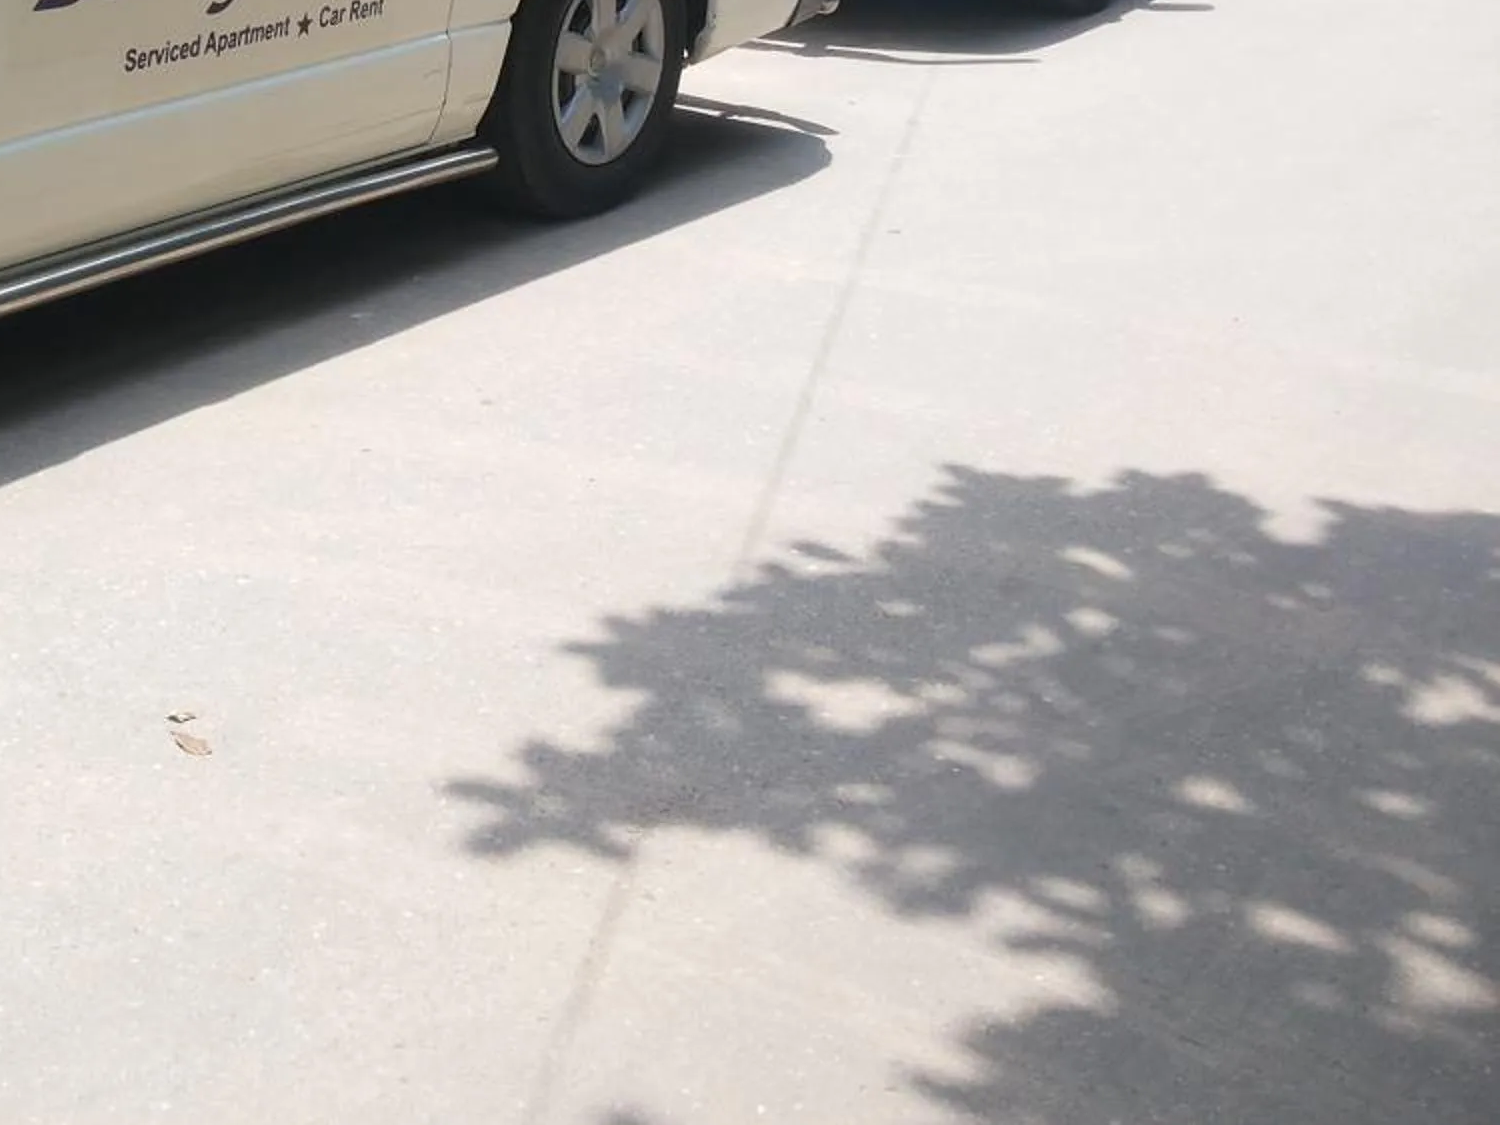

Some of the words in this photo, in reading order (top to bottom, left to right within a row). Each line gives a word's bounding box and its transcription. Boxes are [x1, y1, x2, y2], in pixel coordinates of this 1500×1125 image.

[124, 35, 201, 72] Serviced
[204, 17, 290, 57] Apartment
[319, 5, 346, 28] Car
